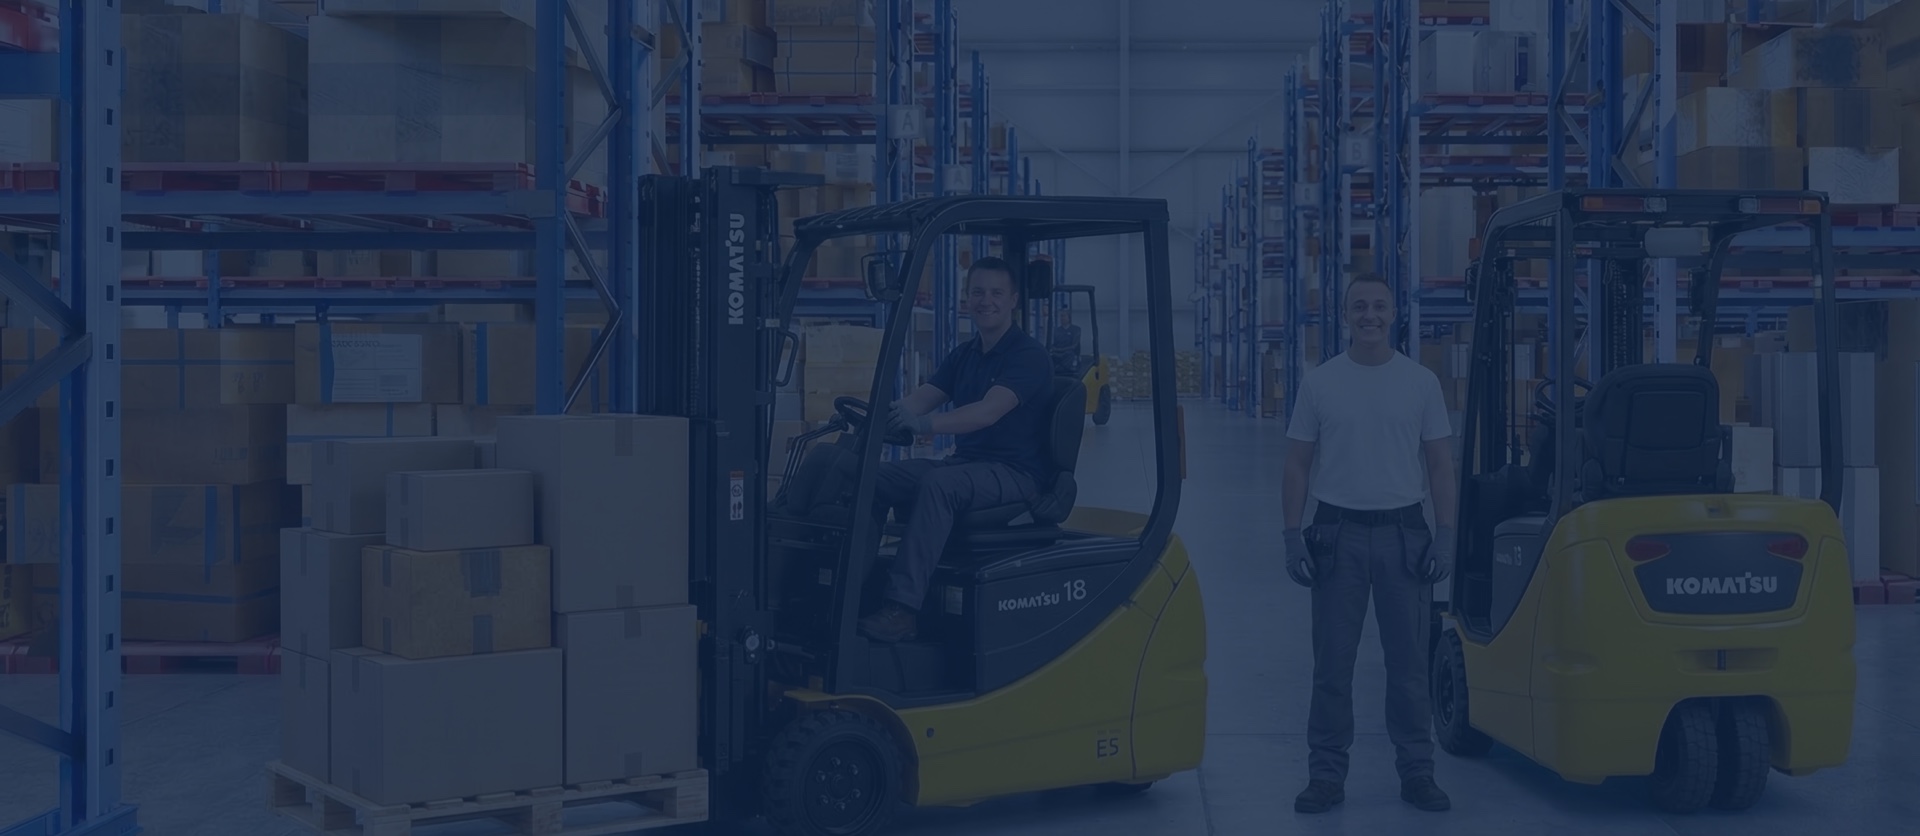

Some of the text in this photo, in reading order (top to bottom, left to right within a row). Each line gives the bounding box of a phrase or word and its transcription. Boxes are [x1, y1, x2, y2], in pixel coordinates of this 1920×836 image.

[902, 111, 914, 131] A
[725, 213, 745, 325] KOMATSU
[1666, 571, 1778, 595] KOMATSU
[998, 579, 1087, 612] KOMATSU 18
[1097, 737, 1119, 758] ES
